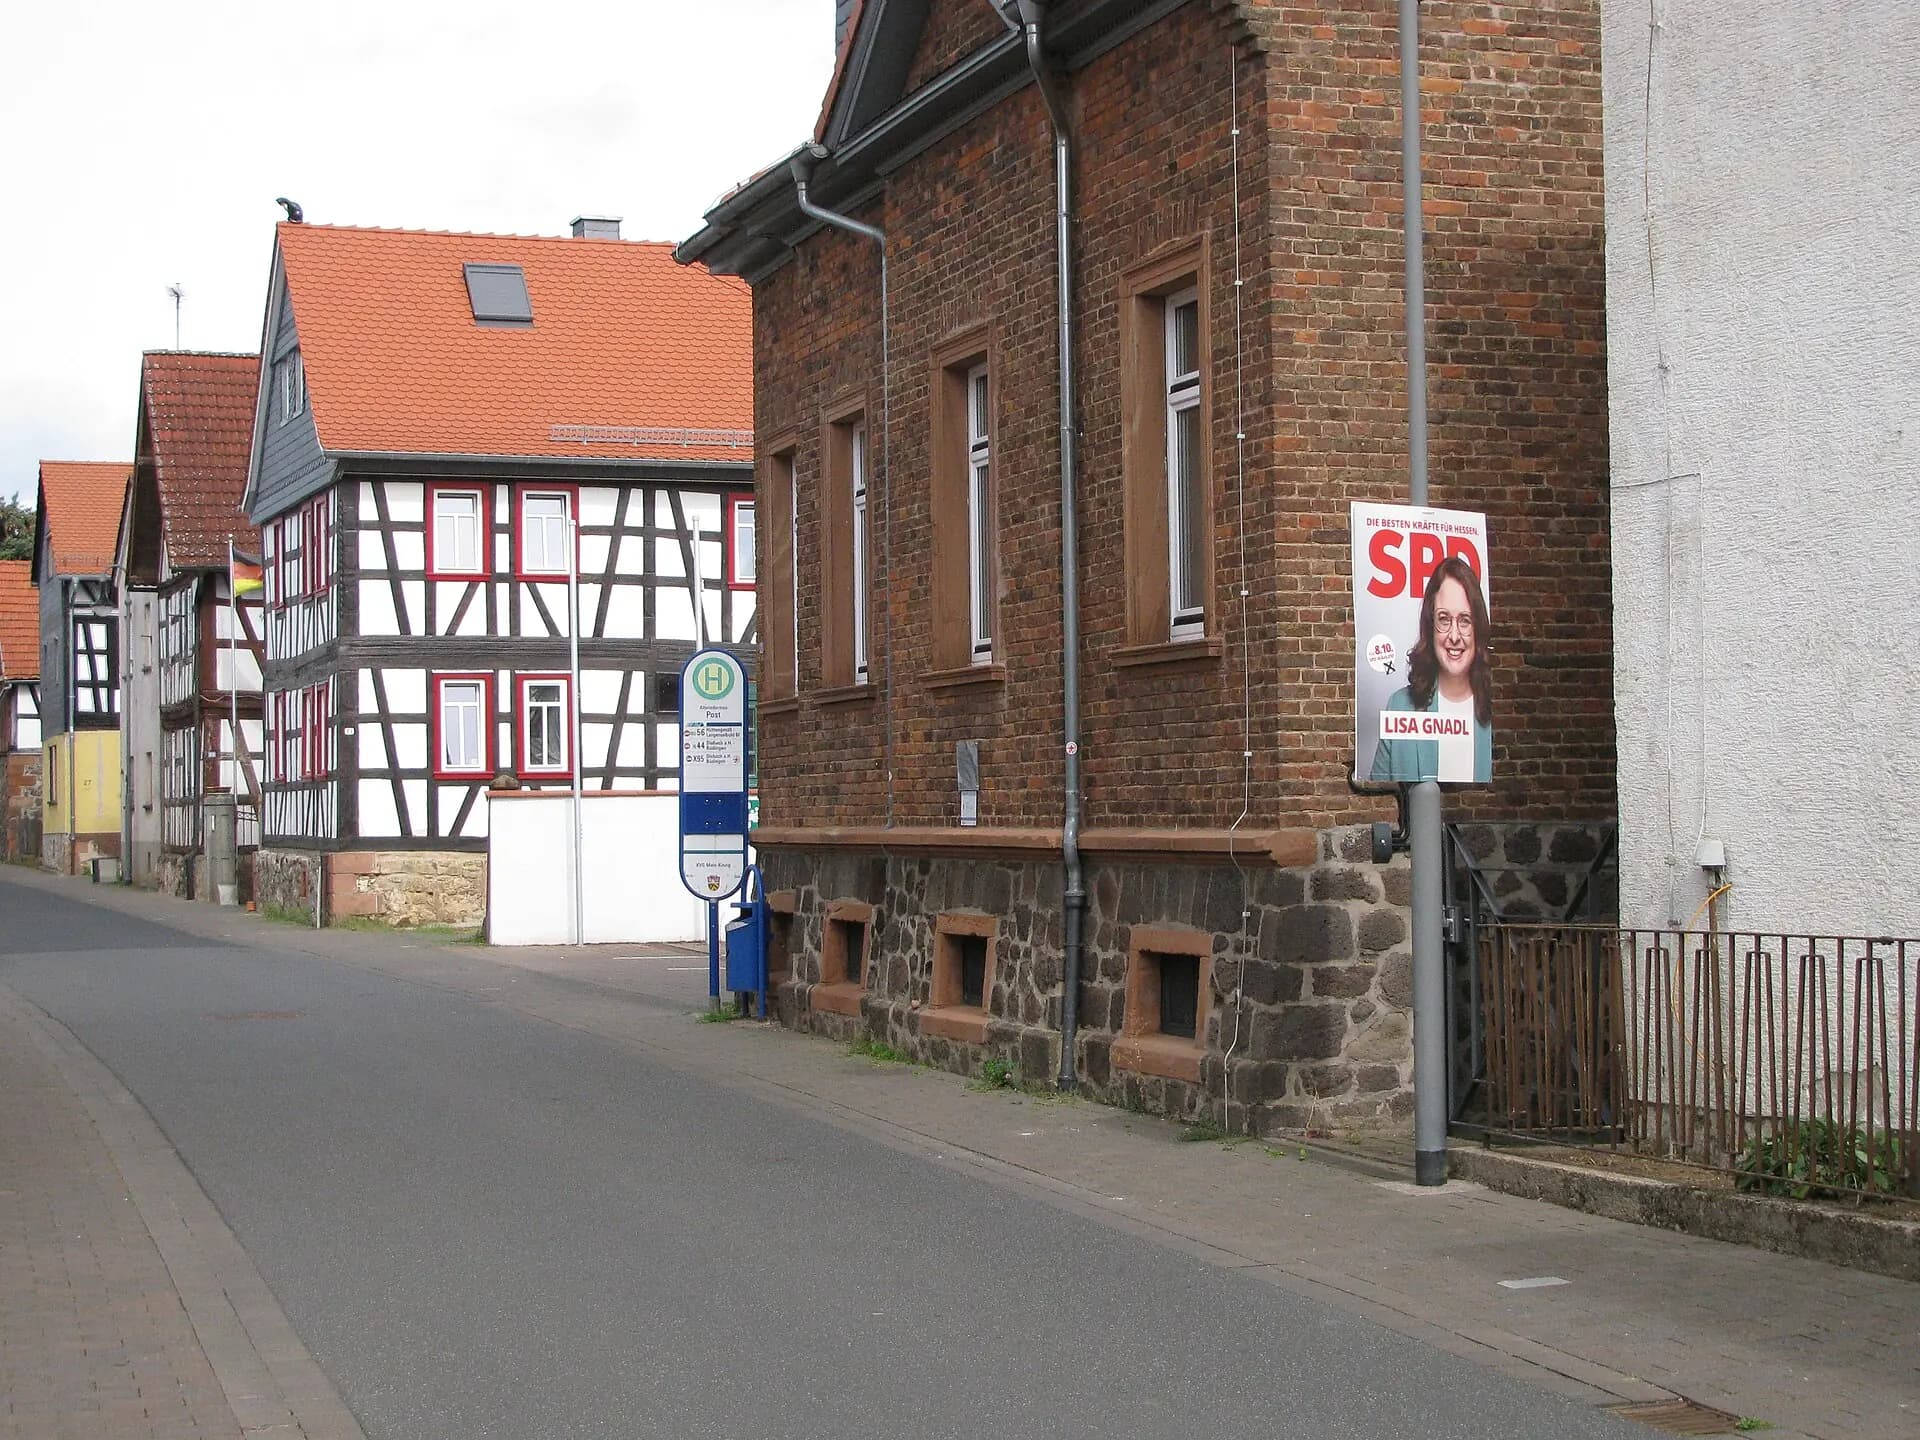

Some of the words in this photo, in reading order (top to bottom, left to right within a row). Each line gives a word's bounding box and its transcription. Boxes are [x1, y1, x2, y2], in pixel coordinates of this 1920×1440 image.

[1366, 517, 1380, 527] DIE
[1381, 518, 1411, 529] BESTEN
[1412, 519, 1440, 532] KRÄFTE
[1440, 521, 1453, 533] FÜR
[1454, 524, 1480, 537] HESSEN.
[704, 666, 723, 691] H
[706, 711, 721, 719] Post
[696, 728, 706, 736] 56
[1384, 717, 1419, 735] LISA
[1422, 718, 1470, 736] GNADL
[696, 741, 705, 749] 44
